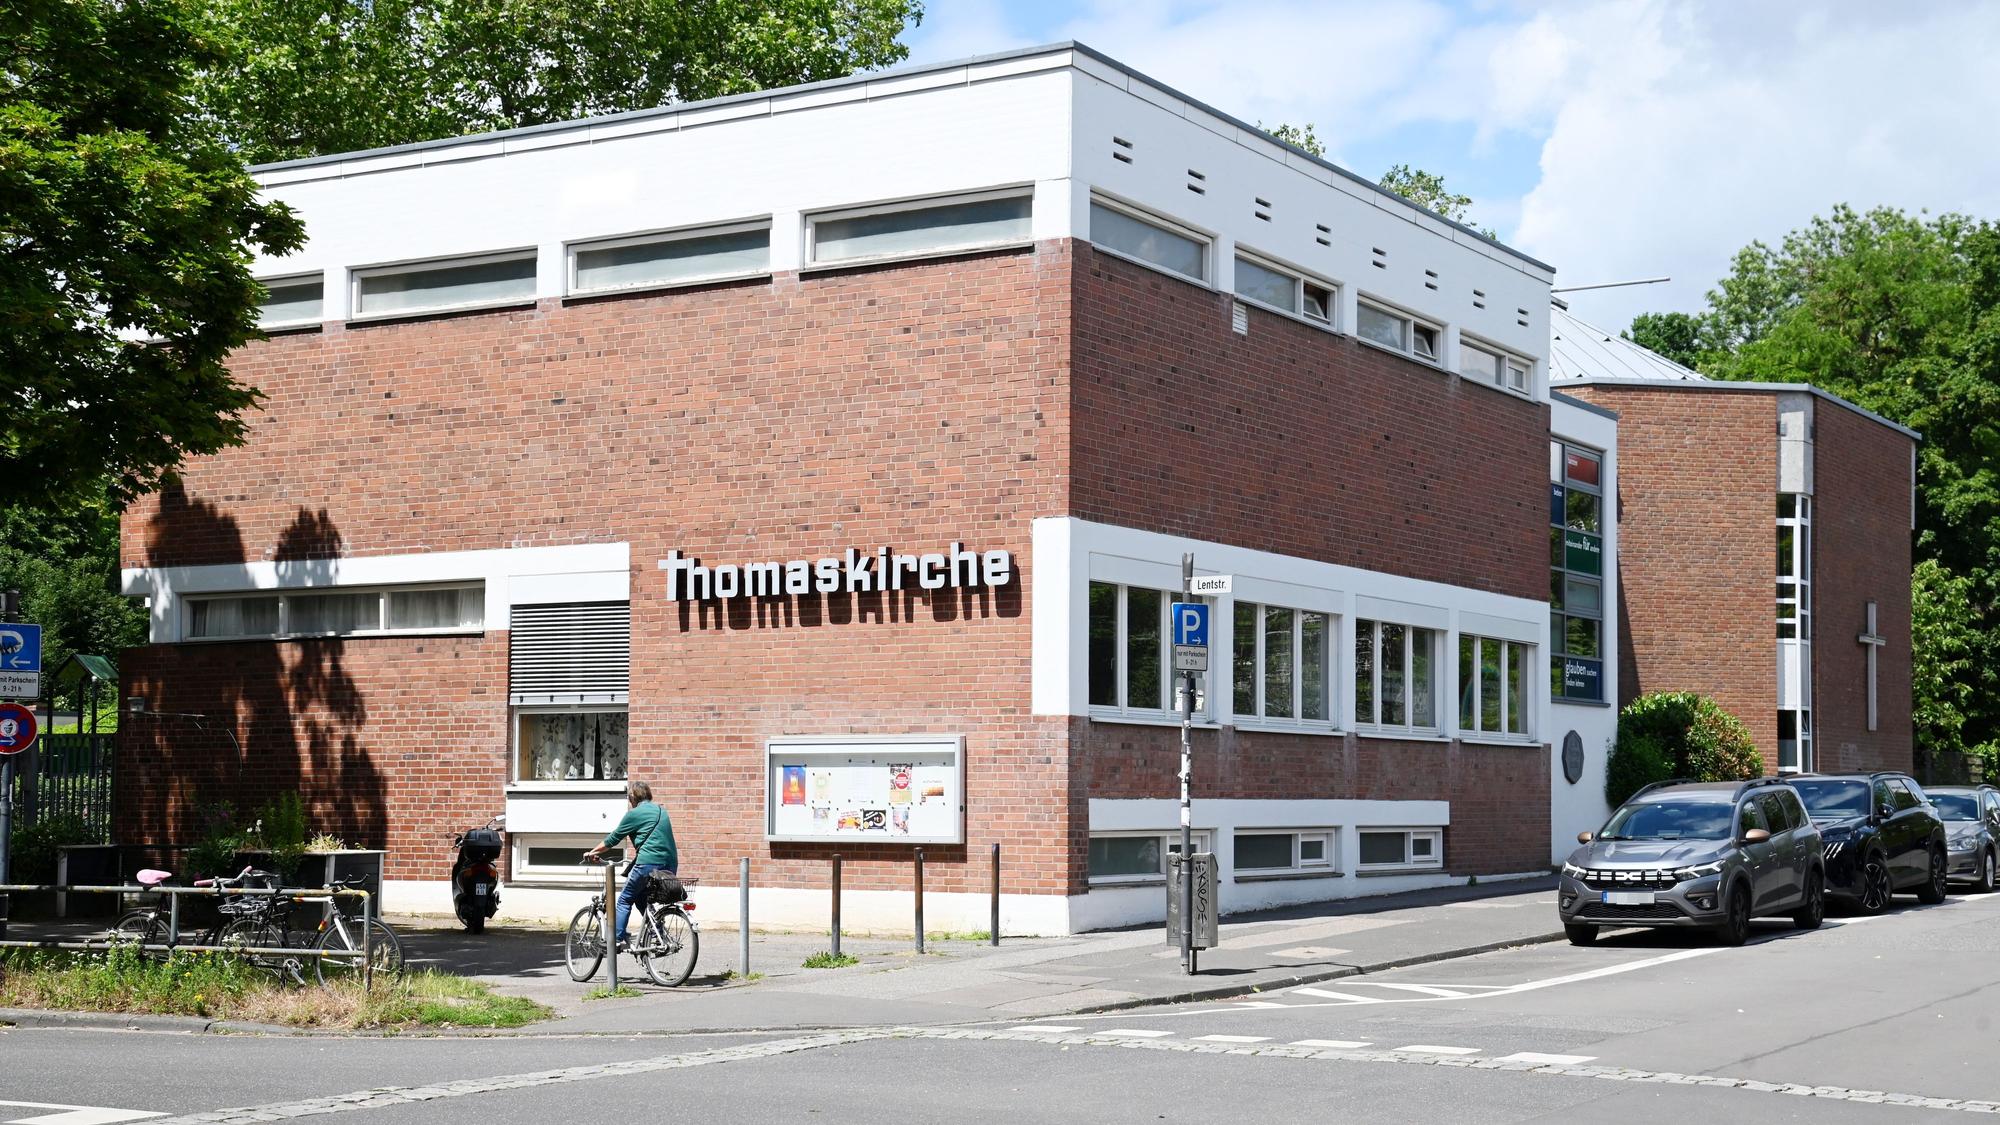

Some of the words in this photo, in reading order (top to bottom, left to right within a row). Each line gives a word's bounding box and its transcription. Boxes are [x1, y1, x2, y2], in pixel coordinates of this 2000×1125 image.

[1197, 579, 1227, 590] Lentstr.
[1182, 609, 1201, 644] P
[0, 630, 24, 668] P
[1565, 660, 1586, 677] glauben
[8, 676, 36, 684] Parkschein
